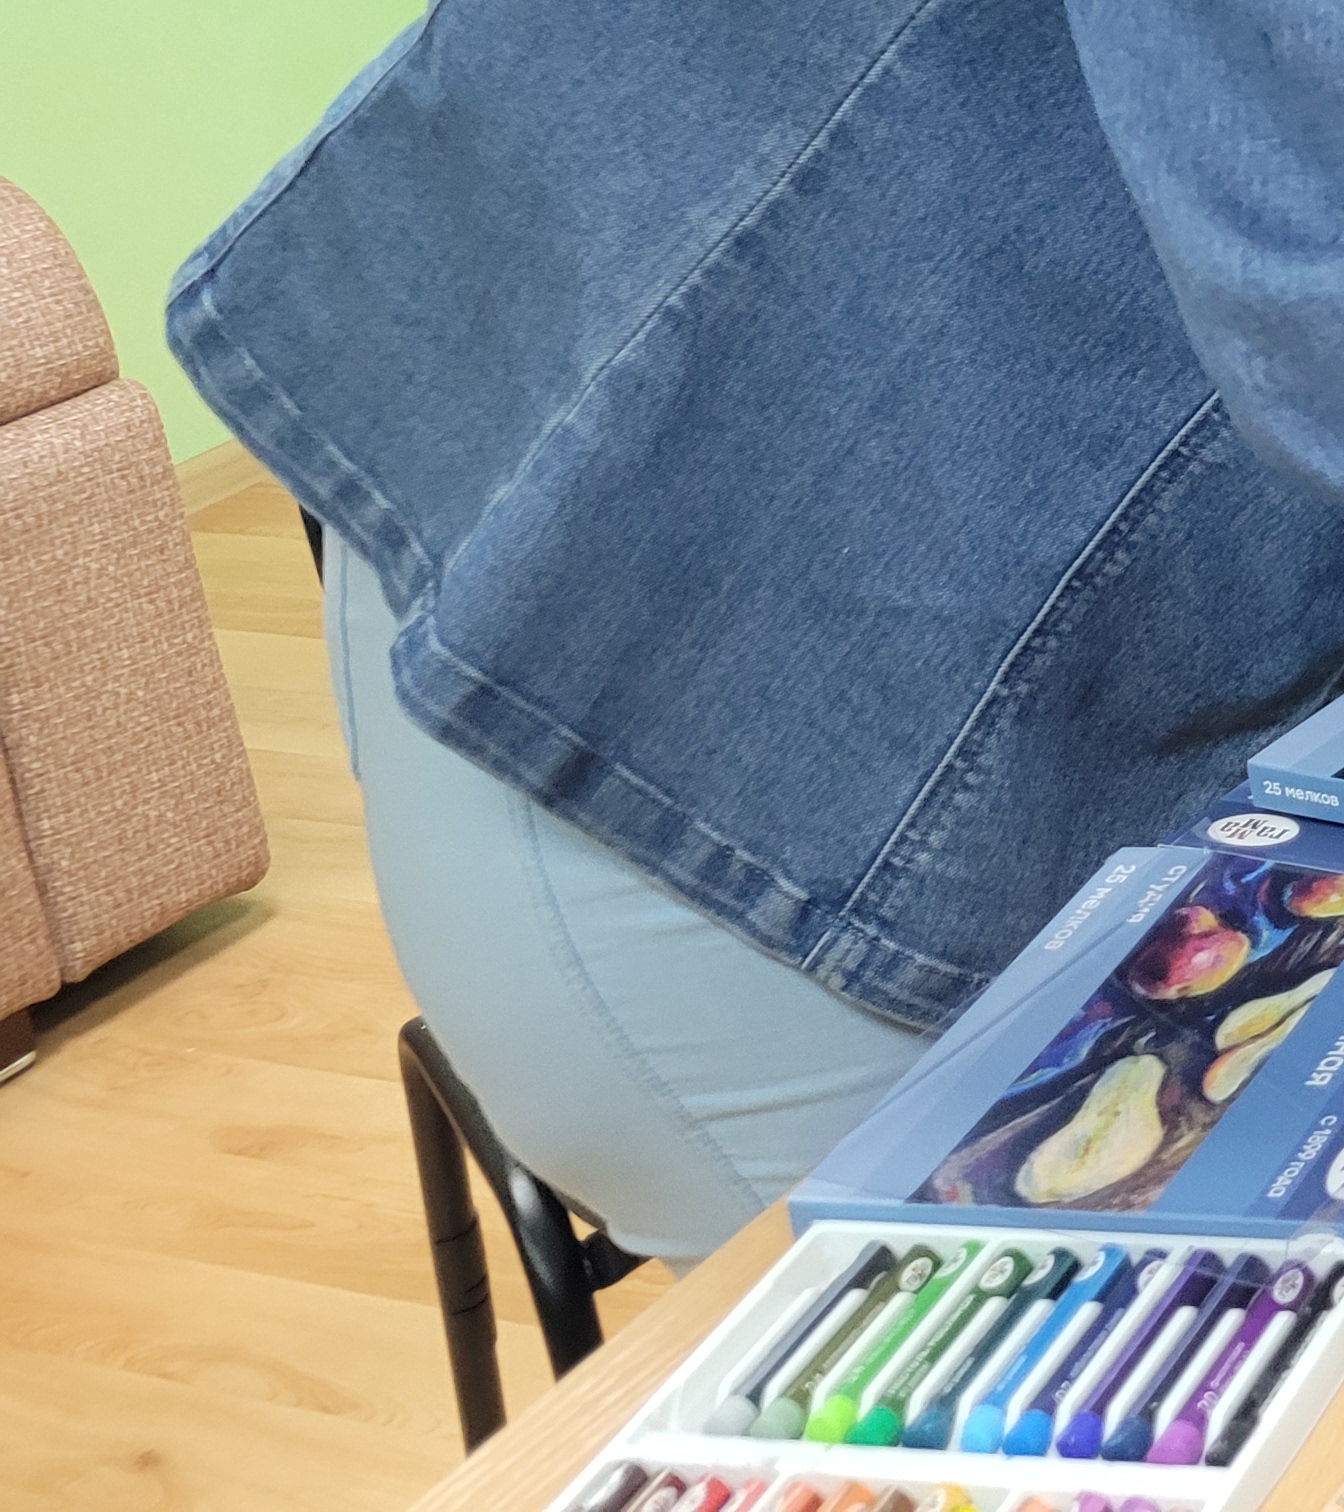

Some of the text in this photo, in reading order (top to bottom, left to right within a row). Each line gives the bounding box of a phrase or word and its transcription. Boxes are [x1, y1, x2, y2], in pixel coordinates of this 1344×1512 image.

[1263, 779, 1340, 807] 25 мелков
[1044, 863, 1137, 951] 25 мелков
[1297, 1129, 1333, 1161] 1899
[1266, 1161, 1305, 1198] года
